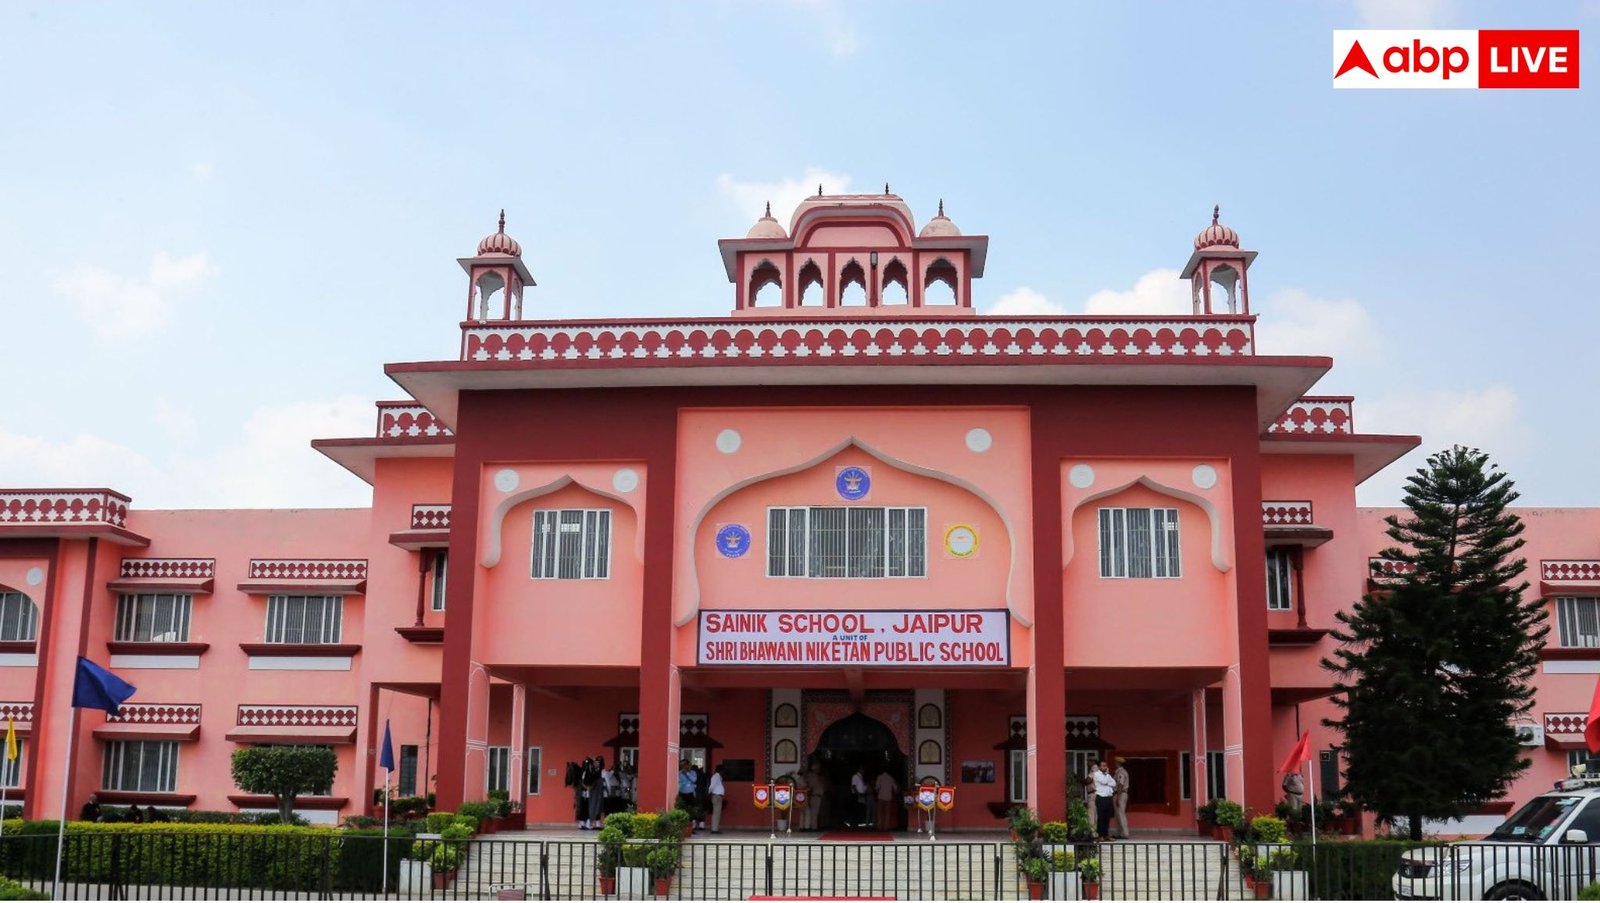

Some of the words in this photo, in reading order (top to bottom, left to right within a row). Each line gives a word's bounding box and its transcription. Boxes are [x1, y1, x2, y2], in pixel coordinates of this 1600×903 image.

[706, 613, 768, 633] SAINIK
[892, 613, 983, 634] JAIPUR
[706, 641, 737, 660] SHRI
[740, 641, 802, 661] BHAWANI
[806, 641, 870, 662] NIKETAN
[874, 641, 935, 662] PUBLIC
[939, 641, 1004, 662] SCHOOL
